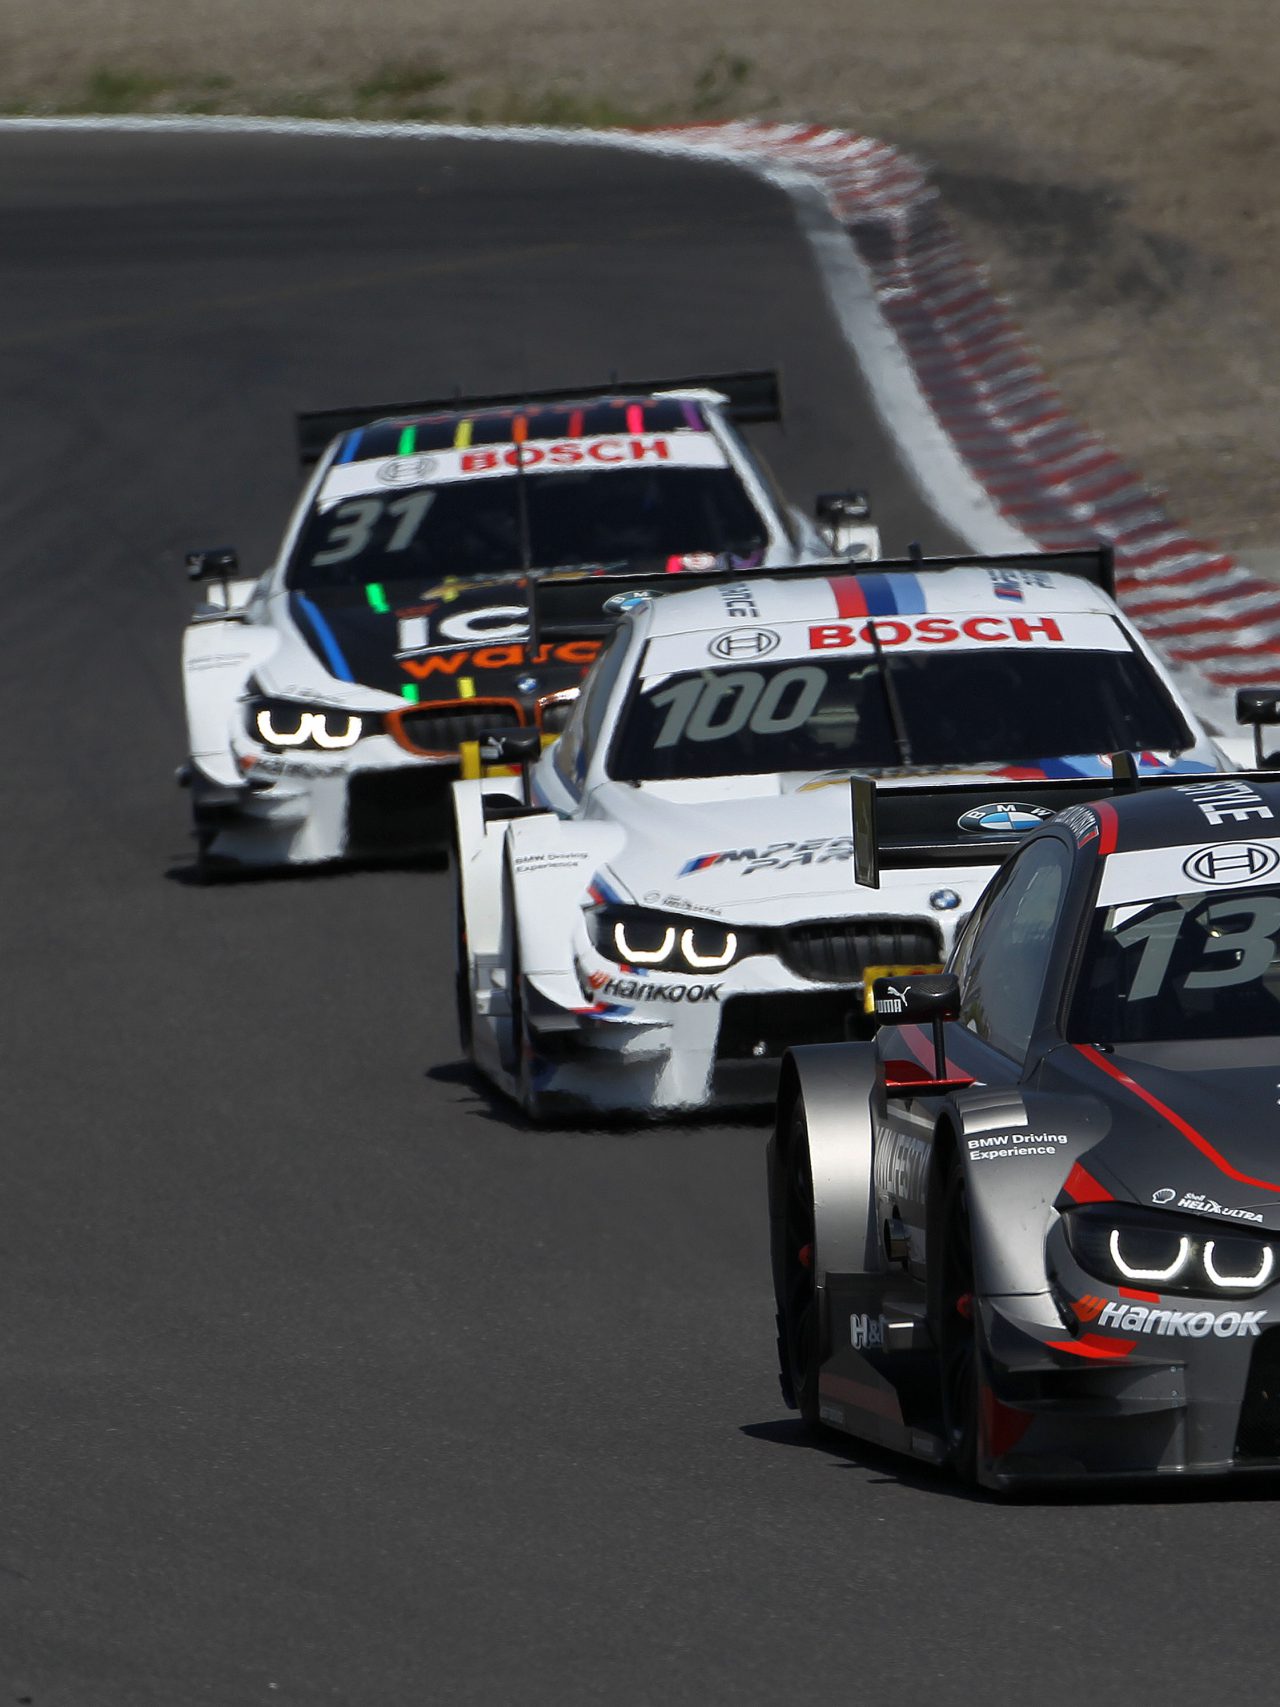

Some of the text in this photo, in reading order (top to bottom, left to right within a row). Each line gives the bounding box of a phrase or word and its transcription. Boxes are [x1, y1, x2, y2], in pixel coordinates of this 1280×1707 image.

[459, 439, 672, 473] BOSCH
[311, 490, 437, 567] 31
[807, 617, 1065, 650] BOSCH
[652, 666, 828, 749] 100
[876, 998, 902, 1013] UMA
[967, 1133, 1069, 1149] BMW Driving
[969, 1146, 1057, 1161] Experience
[1177, 1198, 1264, 1223] HELIX ULTRA
